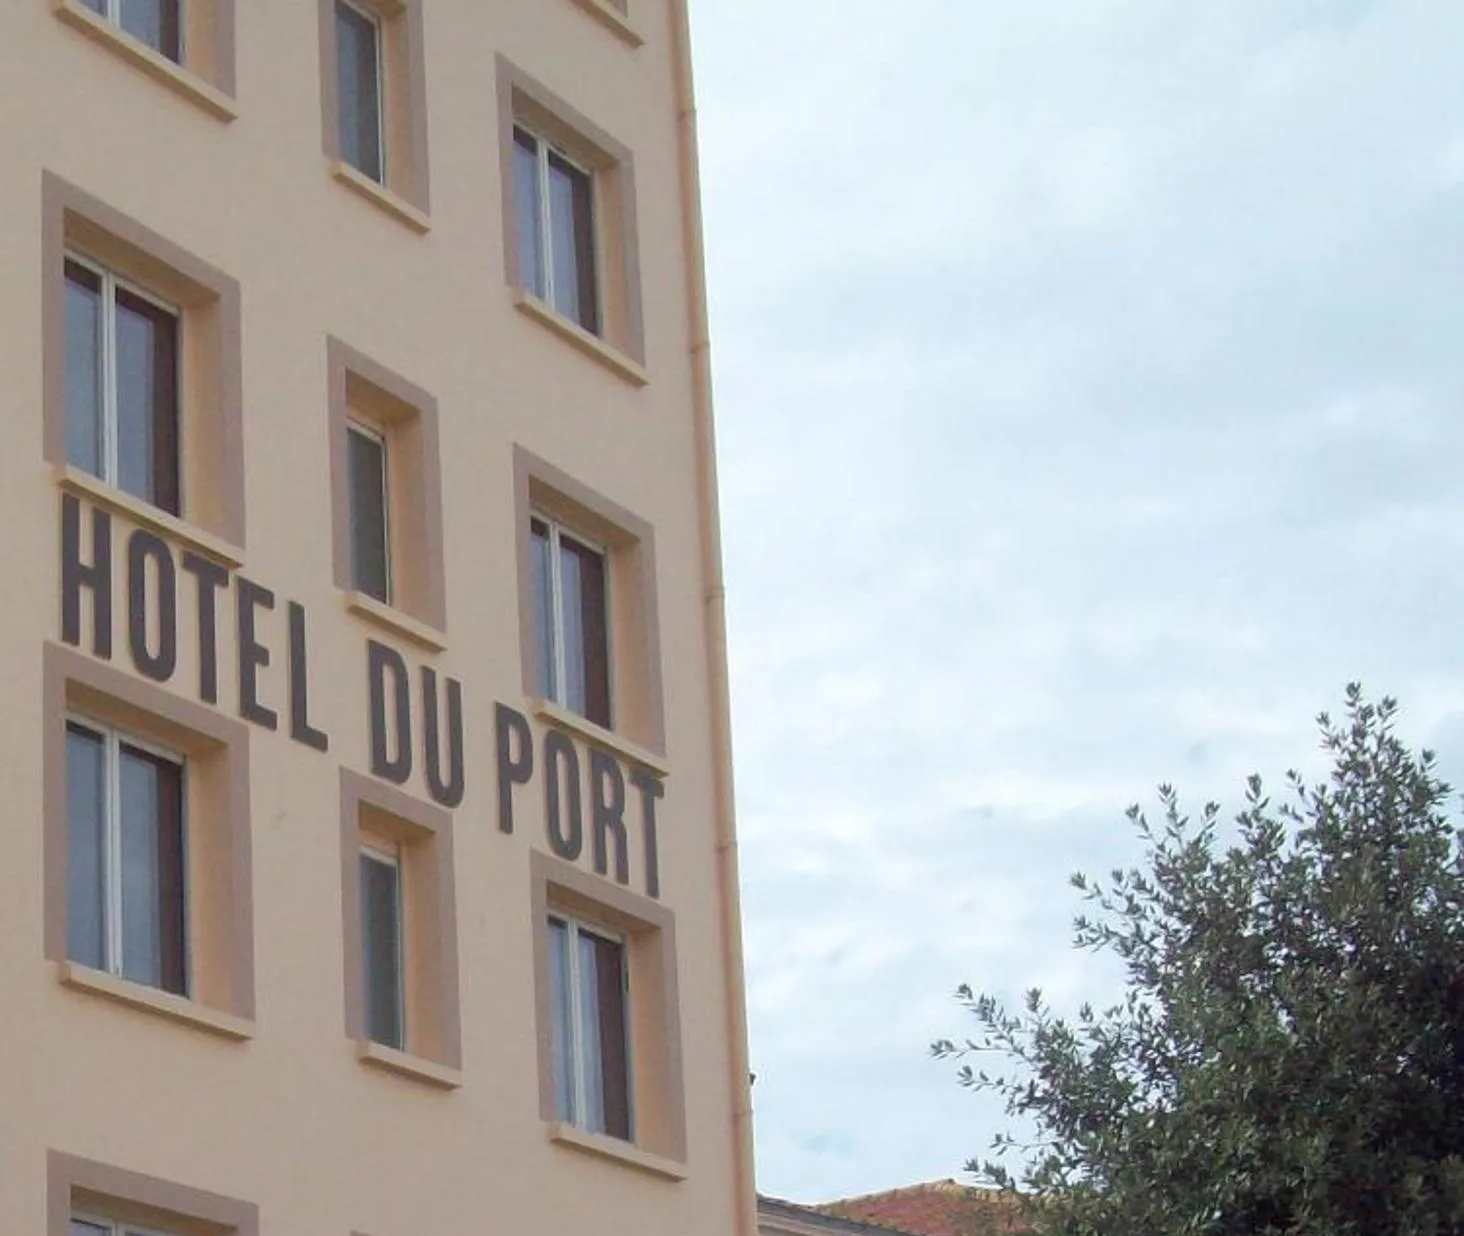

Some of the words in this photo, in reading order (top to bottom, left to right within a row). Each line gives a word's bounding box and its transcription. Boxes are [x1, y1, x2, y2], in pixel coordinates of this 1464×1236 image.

[61, 491, 328, 751] HOTEL
[367, 639, 465, 808] DU
[493, 700, 665, 899] PORT
